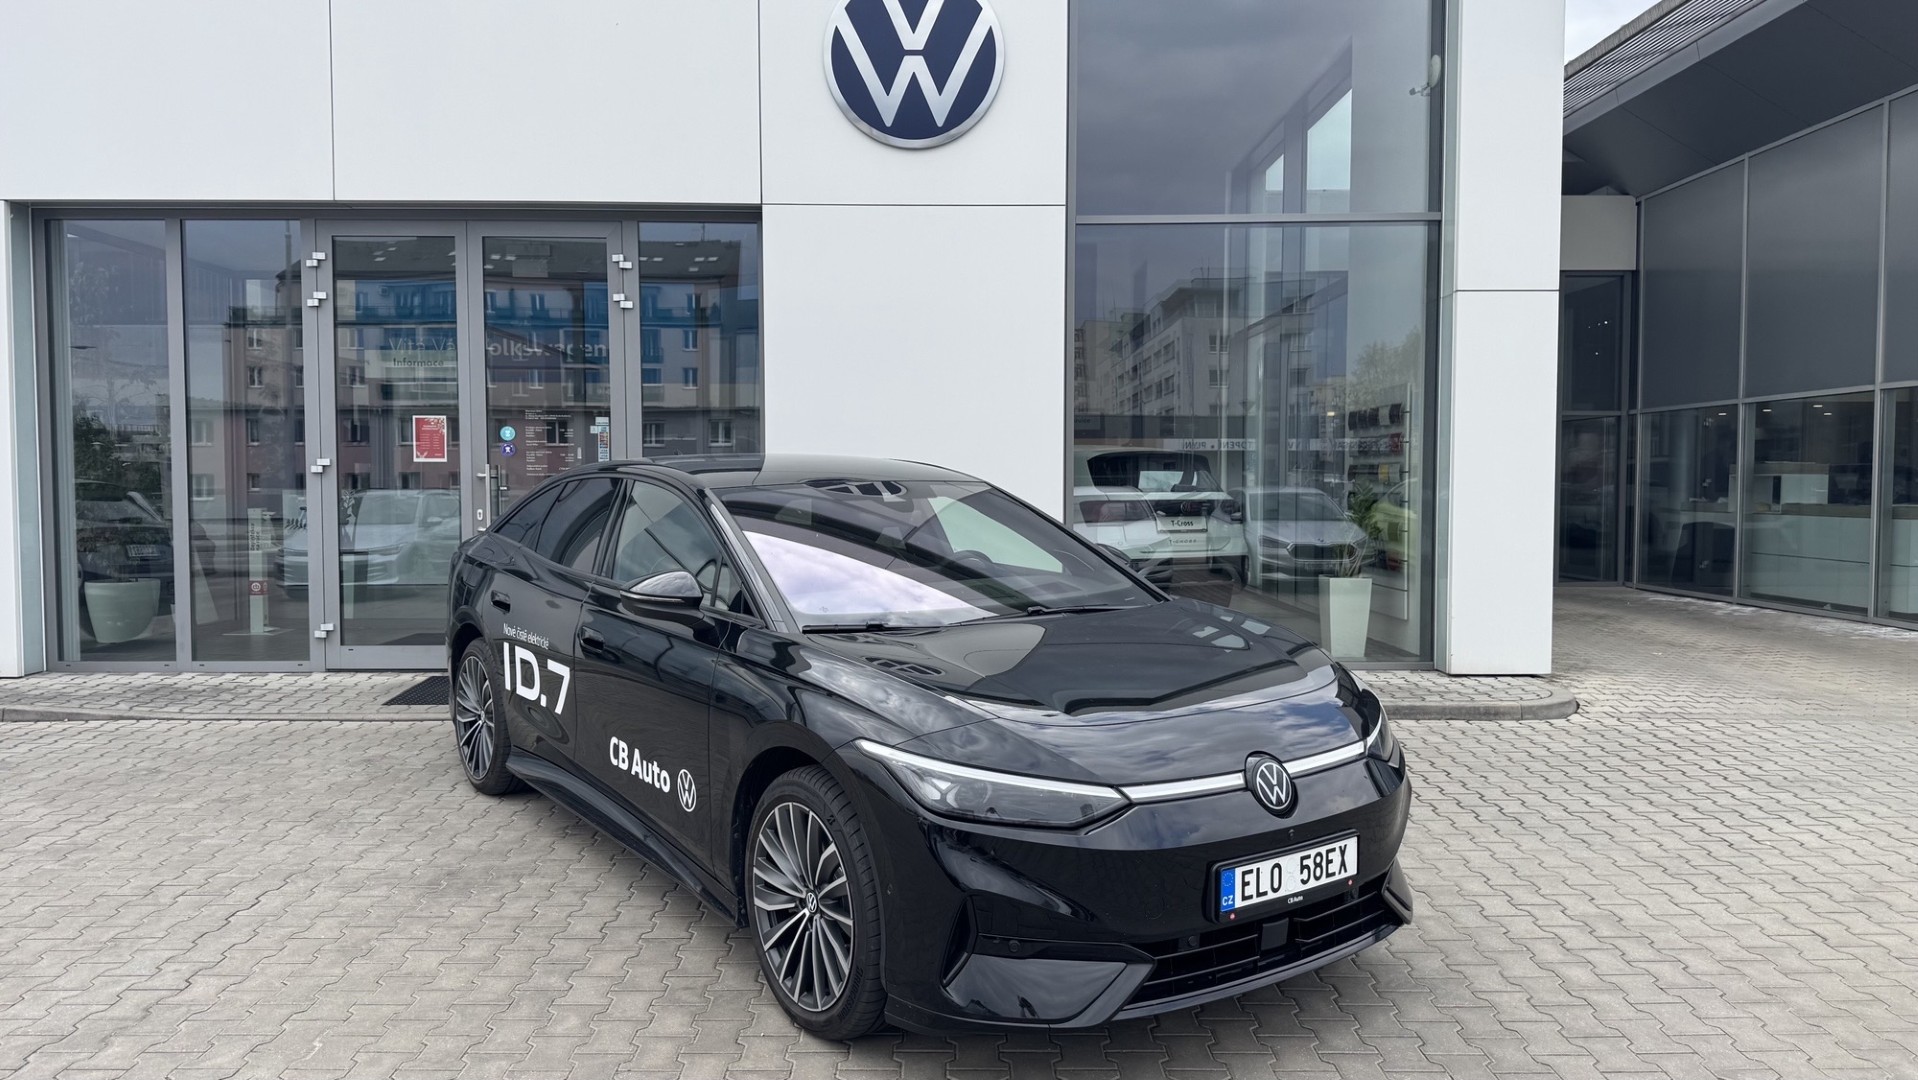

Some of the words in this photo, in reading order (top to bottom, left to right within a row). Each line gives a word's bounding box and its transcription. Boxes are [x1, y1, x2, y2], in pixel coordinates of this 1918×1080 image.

[393, 357, 444, 367] Informace
[503, 622, 516, 638] Nové
[503, 641, 571, 715] ID.7
[609, 736, 629, 771] CB
[630, 748, 671, 794] Auto
[1256, 762, 1292, 810] VW
[677, 768, 697, 812] VW
[1222, 894, 1234, 906] CZ
[1299, 843, 1348, 886] 58EX
